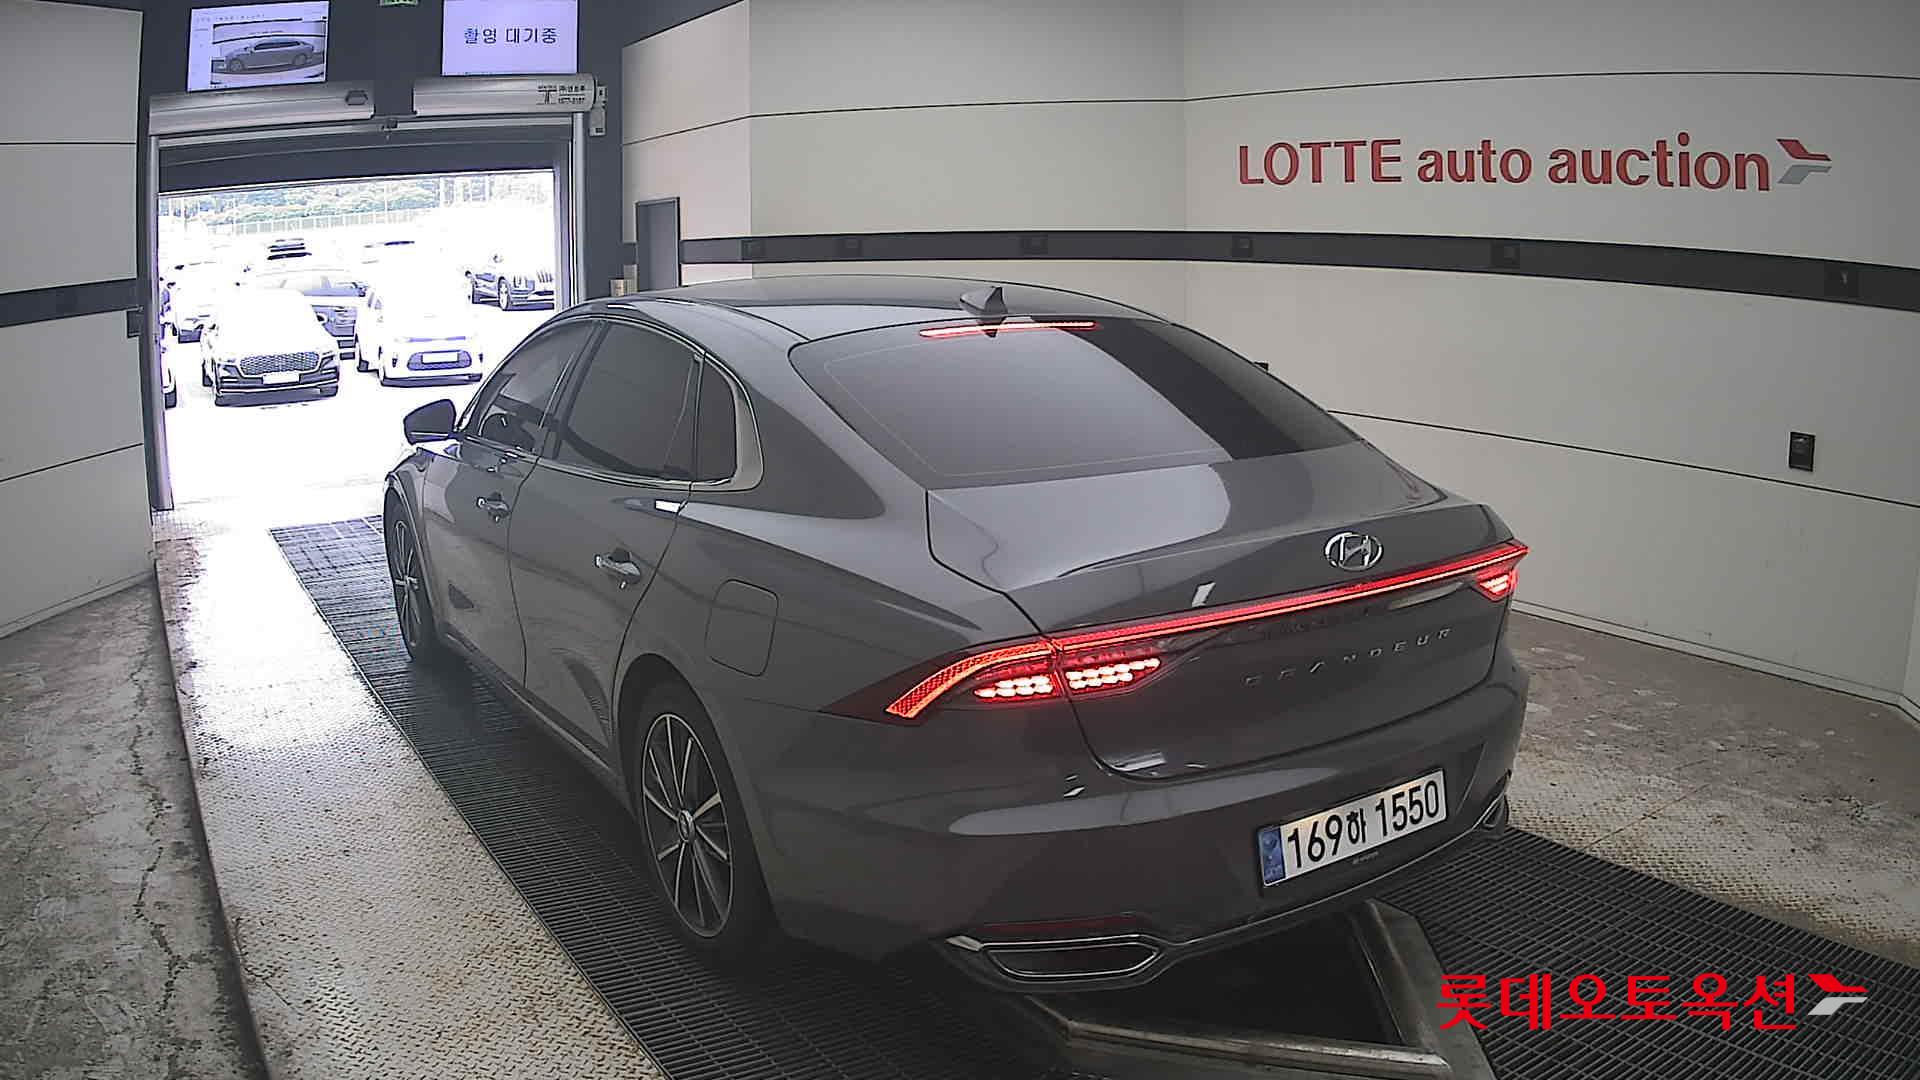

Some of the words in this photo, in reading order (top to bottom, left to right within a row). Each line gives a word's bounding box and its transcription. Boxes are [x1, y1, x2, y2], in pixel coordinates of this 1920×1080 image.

[463, 28, 498, 45] 촬영
[505, 28, 558, 45] 대기중
[1238, 138, 1402, 186] LOTTE
[1417, 139, 1532, 185] auto
[1548, 132, 1771, 191] auction
[1287, 808, 1367, 869] 169하
[1375, 780, 1440, 837] 1550
